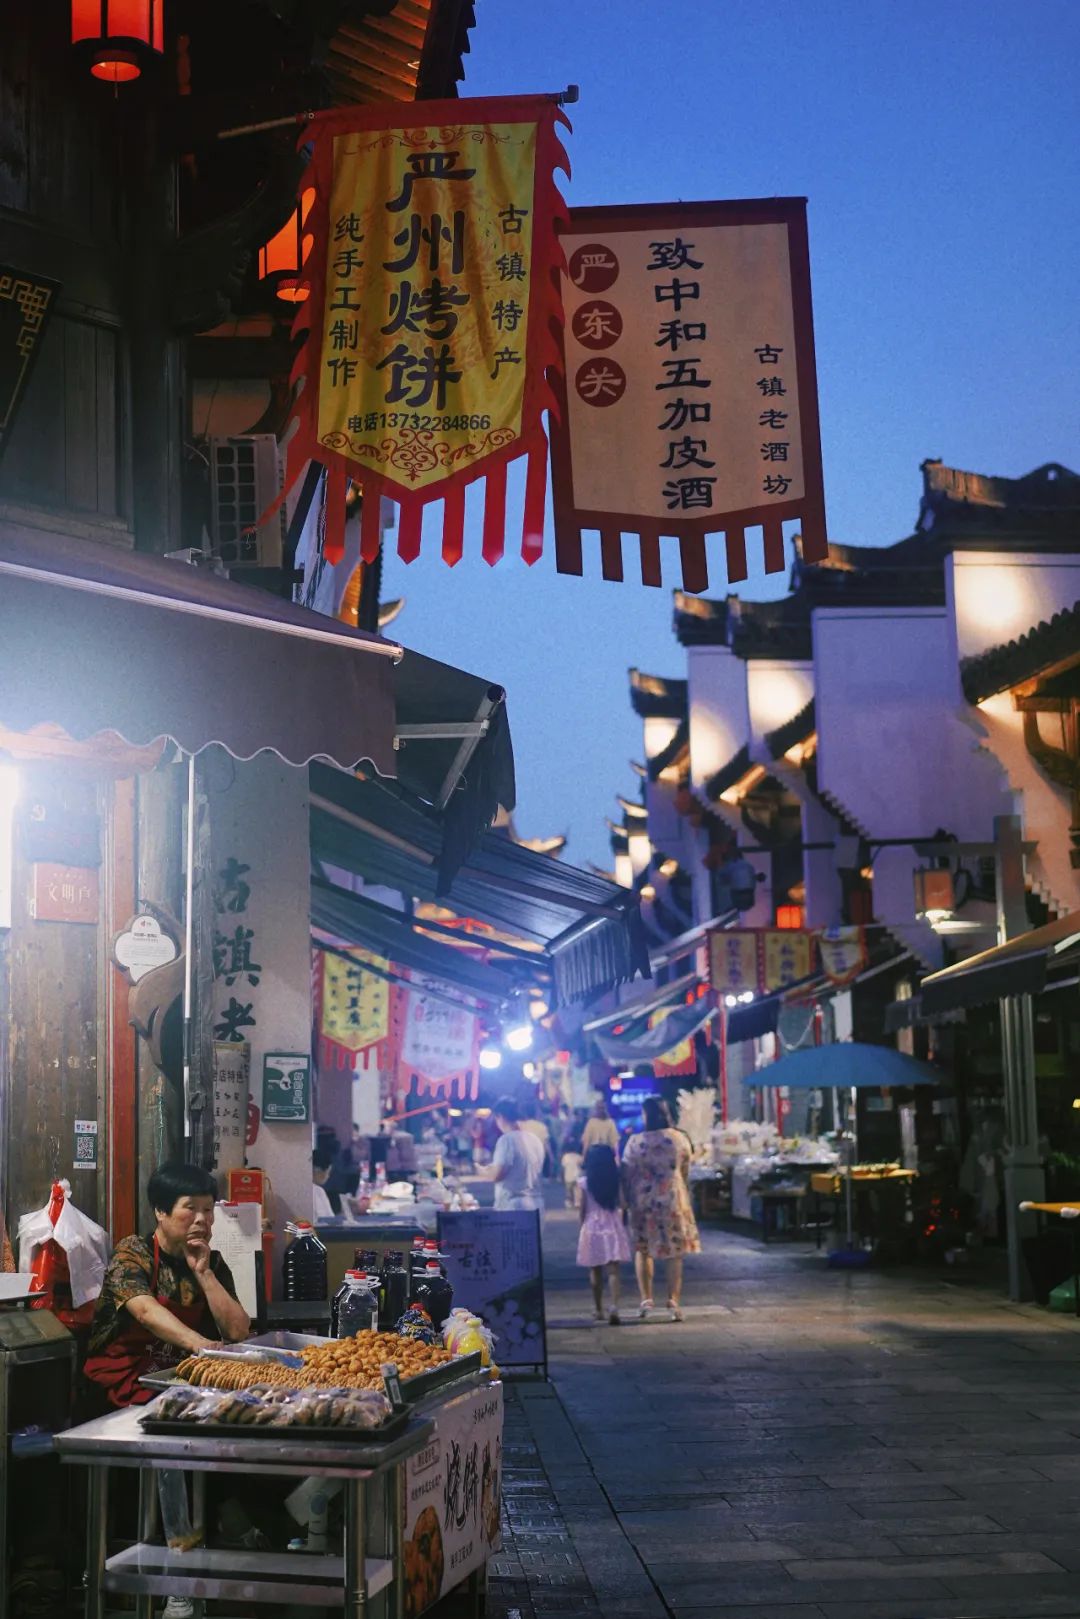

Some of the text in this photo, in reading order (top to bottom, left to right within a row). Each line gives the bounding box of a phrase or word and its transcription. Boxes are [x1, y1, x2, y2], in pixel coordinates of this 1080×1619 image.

[327, 213, 365, 387] 纯手工制作
[376, 151, 477, 410] 严州烤饼
[490, 204, 529, 380] 古镇特产
[573, 254, 623, 398] 严东关
[348, 410, 490, 433] 电话13732284866
[647, 238, 717, 510] 致中和五加皮酒
[754, 344, 792, 495] 古镇老酒坊
